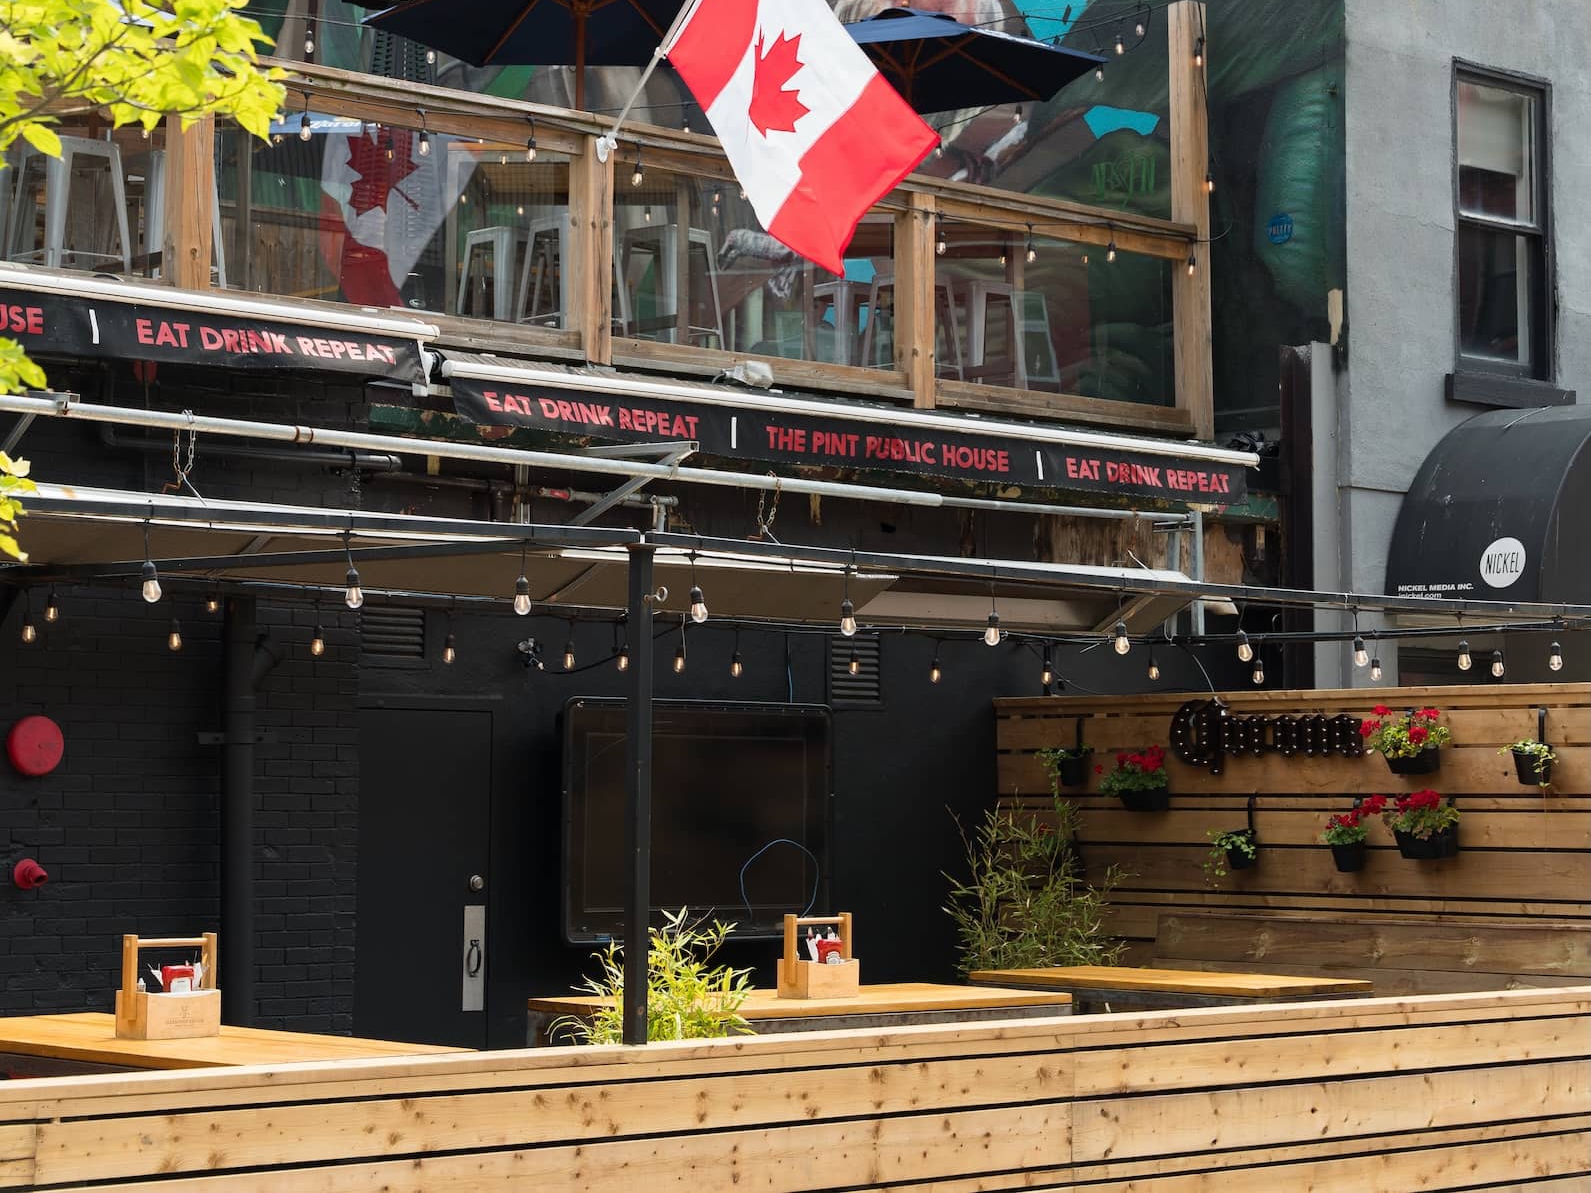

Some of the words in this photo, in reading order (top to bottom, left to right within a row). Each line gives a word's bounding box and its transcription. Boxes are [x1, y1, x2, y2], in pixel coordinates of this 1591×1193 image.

[136, 318, 191, 348] EAT
[200, 326, 293, 355] DRINK
[296, 336, 398, 366] REPEAT
[482, 391, 532, 416] EAT
[538, 398, 615, 428] DRINK
[618, 406, 700, 439] REPEAT
[766, 425, 806, 453] THE
[812, 431, 859, 458] PINT
[865, 436, 937, 466] PUBLIC
[941, 444, 1009, 473] HOUSE
[1065, 457, 1101, 481] EAT
[1106, 462, 1163, 489] DRINK
[1166, 469, 1230, 494] REPEAT
[1485, 551, 1521, 575] NICKEL
[1397, 584, 1428, 592] NICKEL
[1457, 582, 1474, 591] INC.
